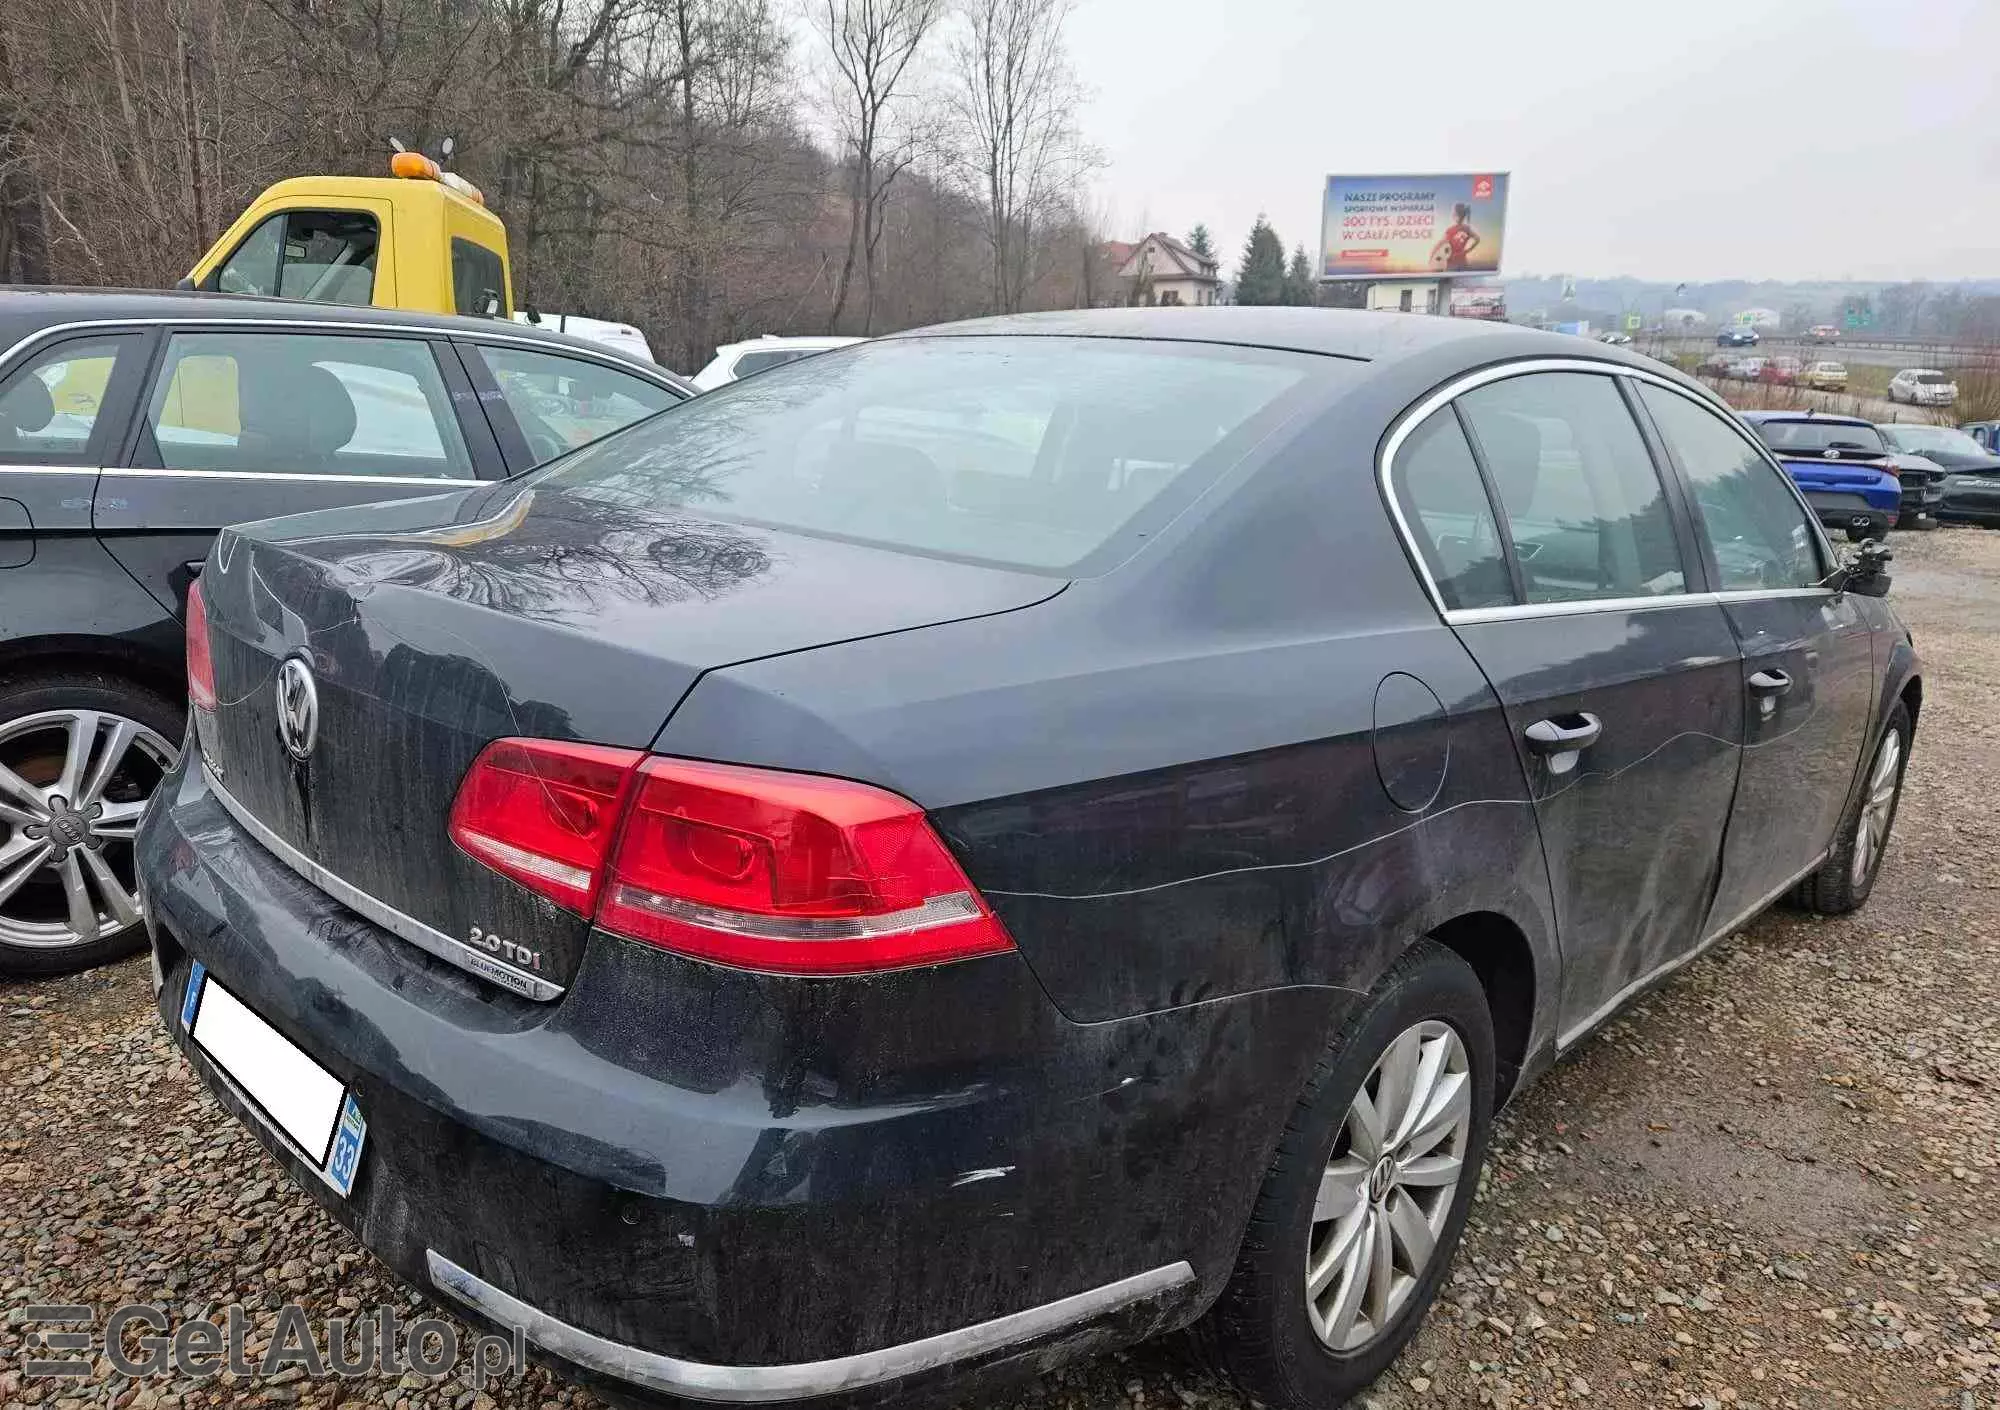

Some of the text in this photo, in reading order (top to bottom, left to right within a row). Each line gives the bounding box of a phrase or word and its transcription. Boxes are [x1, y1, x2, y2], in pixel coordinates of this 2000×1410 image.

[1344, 191, 1436, 201] NASZE PROGRAMY
[1343, 215, 1435, 227] 300 TYS. DZIECI
[1343, 230, 1354, 240] W
[1392, 228, 1433, 240] POLSCE
[334, 1135, 356, 1180] 33
